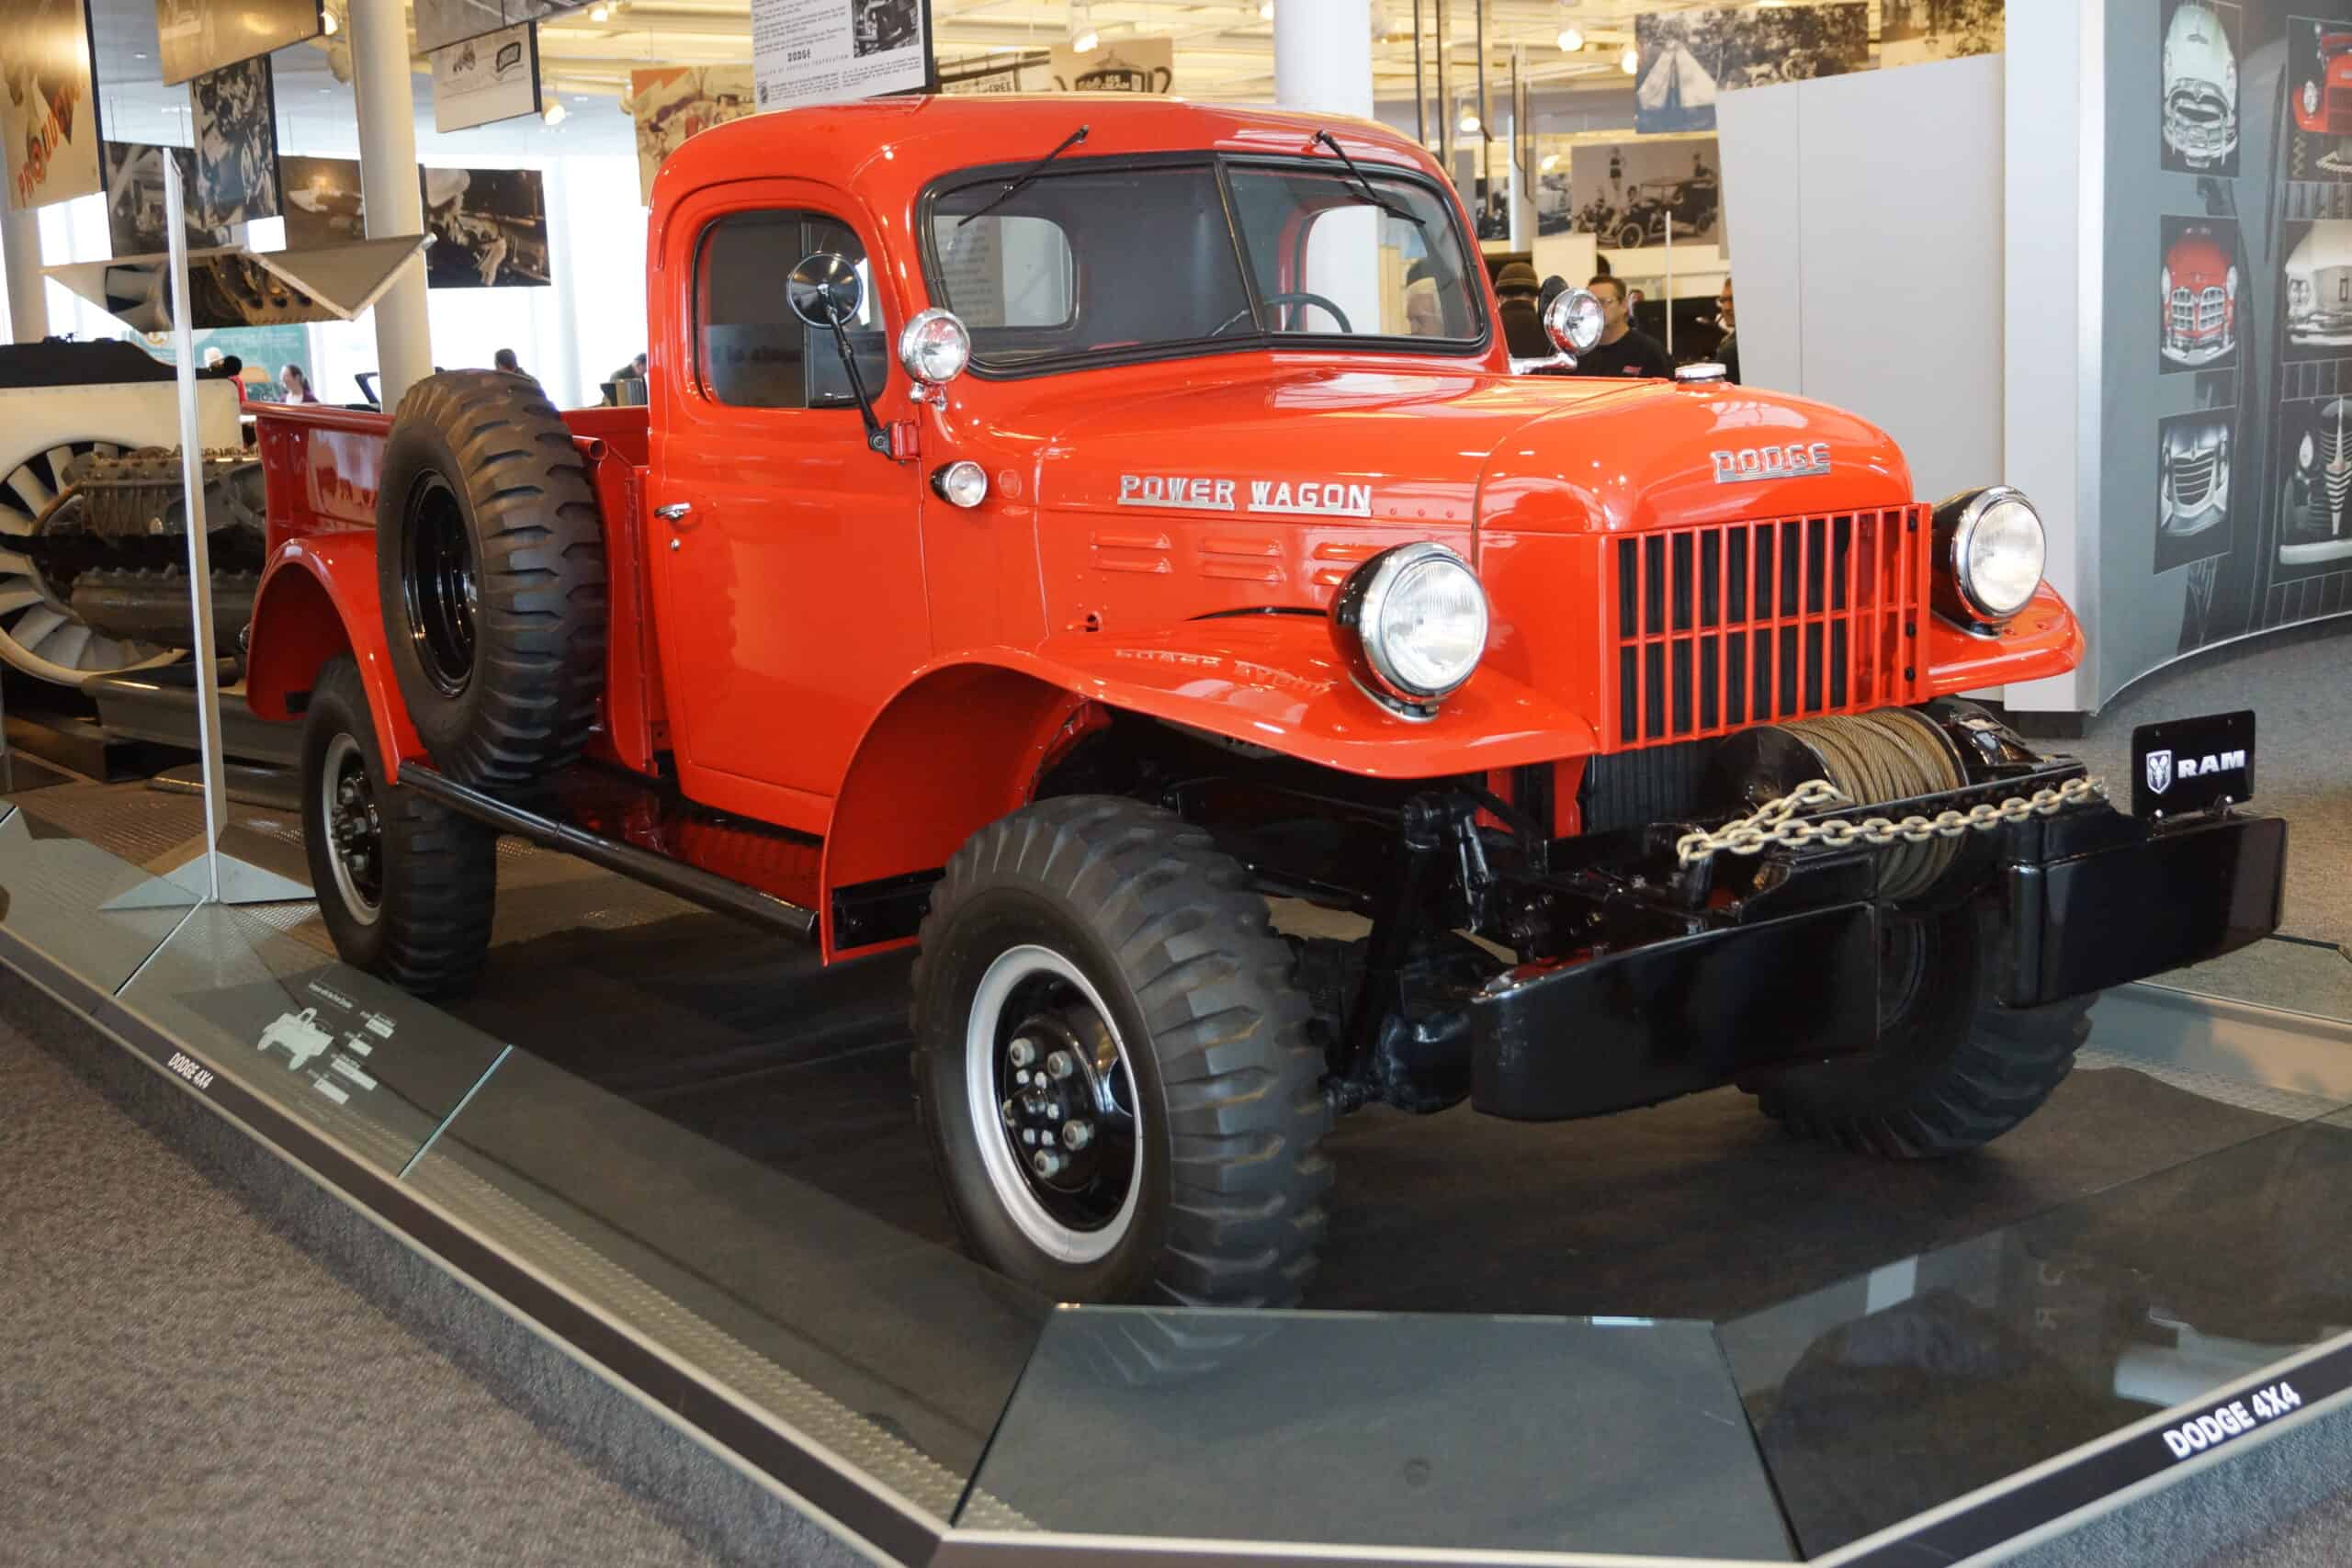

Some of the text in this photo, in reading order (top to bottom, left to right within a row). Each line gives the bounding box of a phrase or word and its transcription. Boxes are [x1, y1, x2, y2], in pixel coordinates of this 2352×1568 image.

[786, 49, 811, 62] DODGE
[1710, 443, 1830, 483] DODGE
[1117, 475, 1373, 517] POWER WAGON
[2177, 750, 2245, 779] RAM
[167, 1052, 199, 1079] DODGE
[2162, 1382, 2301, 1459] DODGE 4X4
